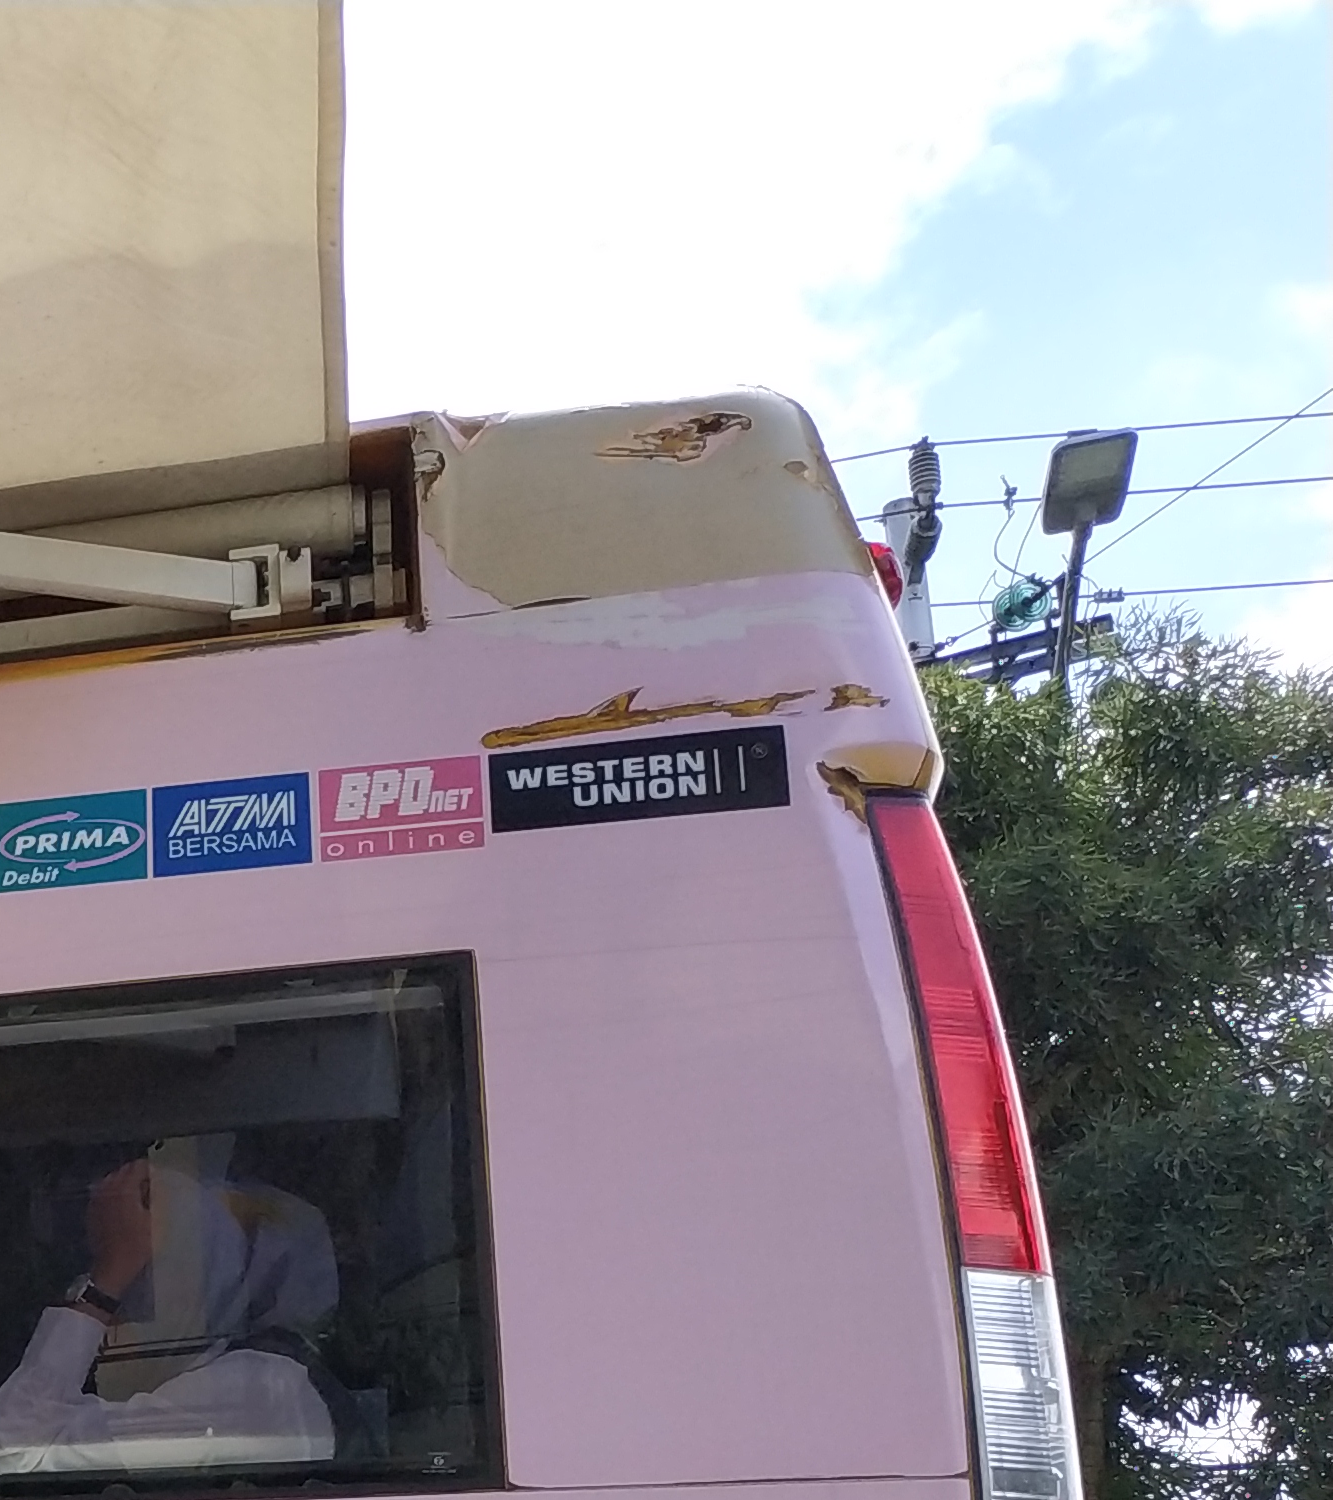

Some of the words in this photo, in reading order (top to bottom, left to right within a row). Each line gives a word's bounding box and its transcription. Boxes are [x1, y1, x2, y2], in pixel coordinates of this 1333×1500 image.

[507, 751, 706, 790] WESTERN
[573, 774, 707, 807] UNION
[167, 790, 296, 838] ATM
[14, 825, 131, 856] PRIMA
[167, 828, 297, 859] BERSAMA
[326, 830, 476, 857] online
[2, 867, 60, 887] Debit
